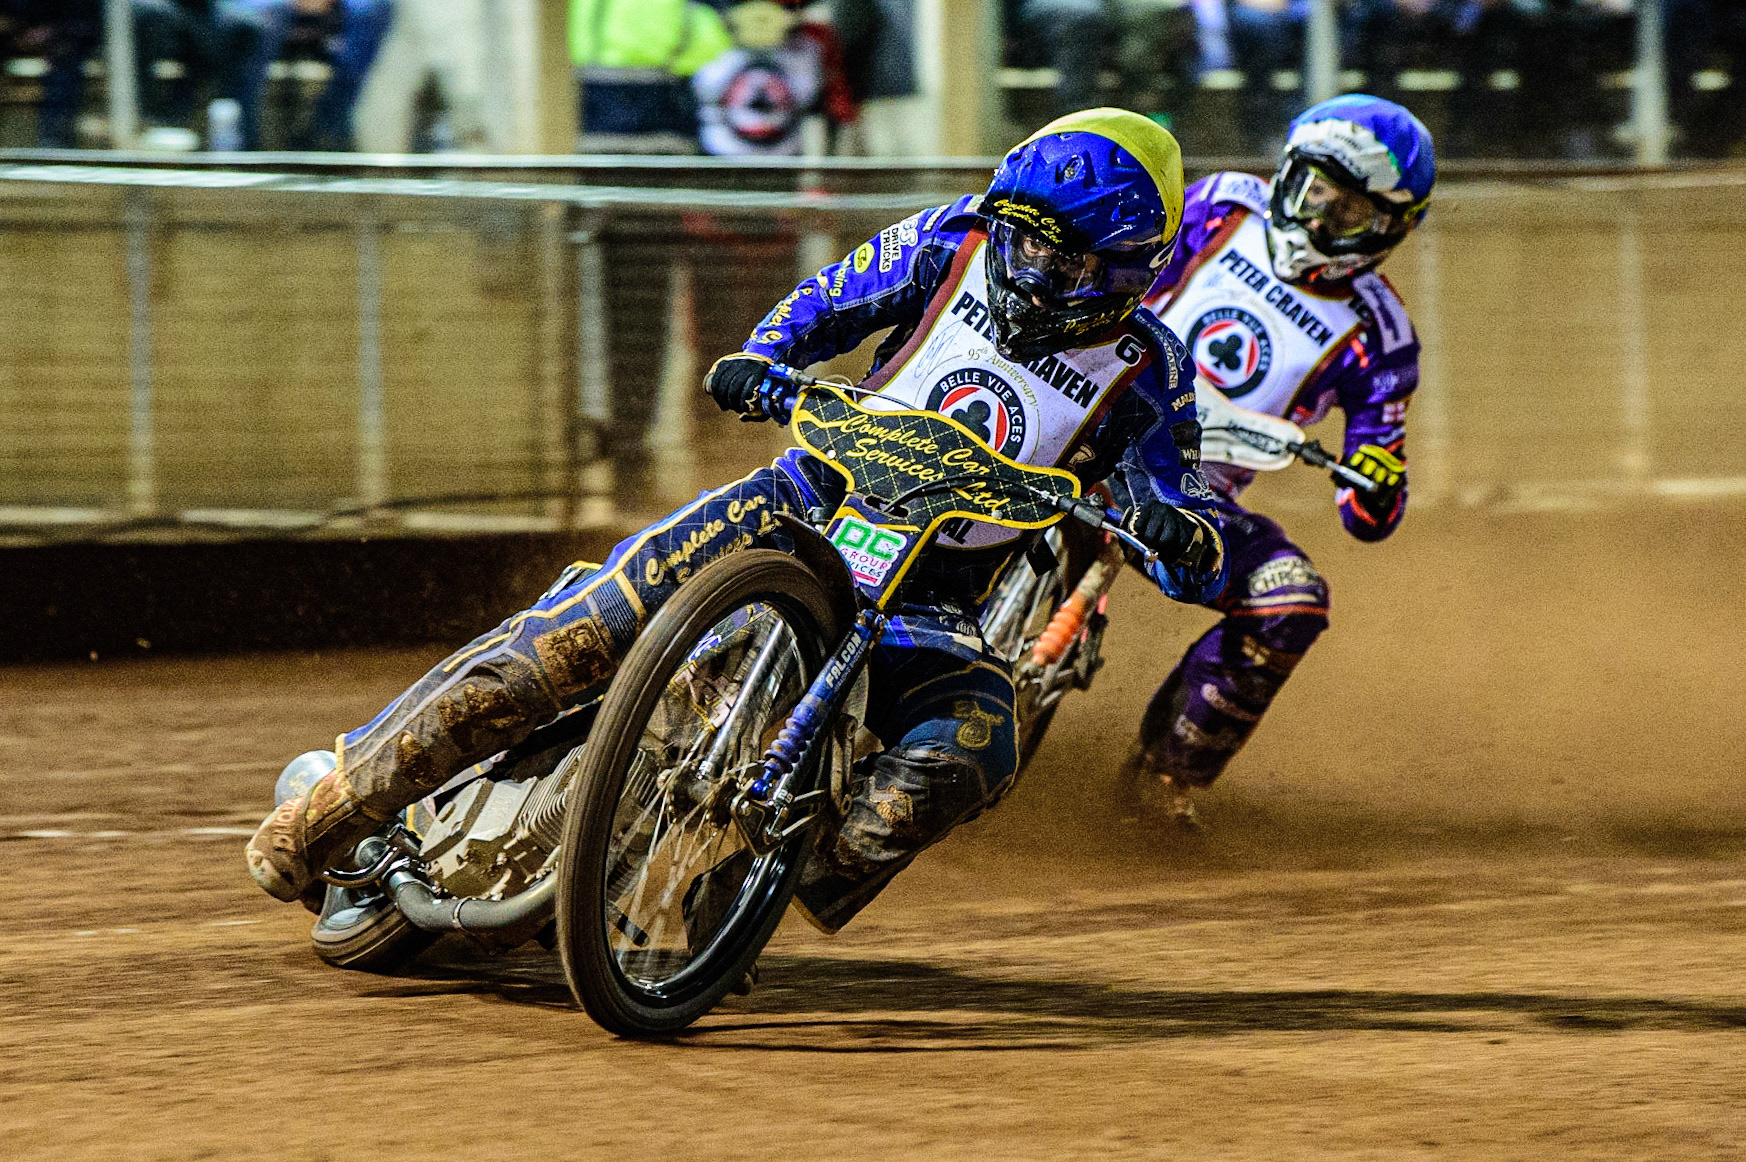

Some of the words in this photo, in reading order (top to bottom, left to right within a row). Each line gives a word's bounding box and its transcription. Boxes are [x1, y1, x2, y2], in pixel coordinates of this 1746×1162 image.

[881, 229, 892, 271] TRUCKS
[891, 227, 901, 259] DRIVE
[950, 290, 995, 343] PET
[1219, 249, 1270, 293] PETER
[1265, 285, 1334, 348] CRAVEN
[1115, 333, 1147, 368] 6
[939, 371, 981, 393] BELLE
[986, 375, 1013, 401] VUE
[1008, 406, 1023, 443] ACES
[985, 354, 1038, 407] Anniversary
[840, 414, 939, 454] Complete
[942, 448, 990, 475] Car
[846, 437, 944, 483] Services
[951, 481, 1011, 513] Ltd
[645, 519, 726, 587] Complete
[727, 494, 767, 524] Car
[834, 519, 901, 561] PC
[840, 547, 888, 570] GROUP
[825, 631, 862, 688] FALCON
